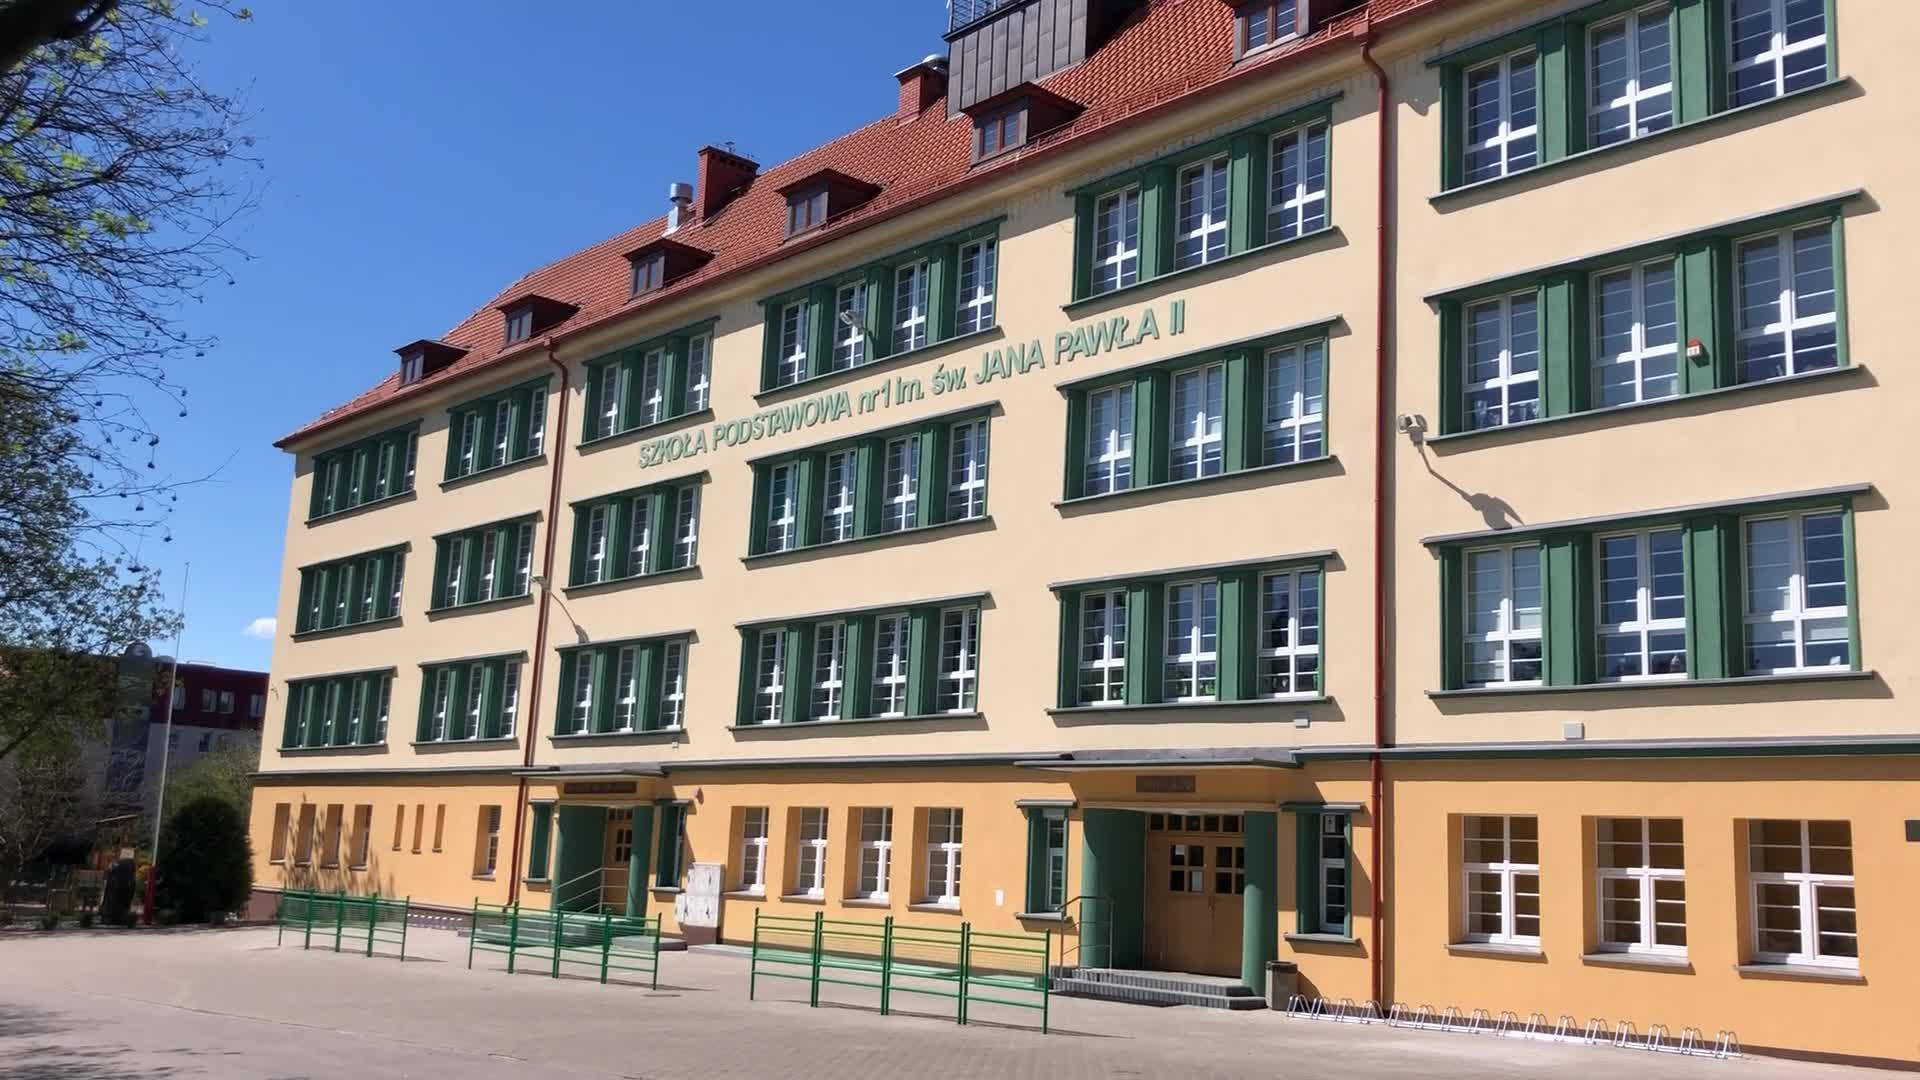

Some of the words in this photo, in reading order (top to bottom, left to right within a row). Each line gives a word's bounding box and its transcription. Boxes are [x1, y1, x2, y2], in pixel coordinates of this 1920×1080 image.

[640, 429, 707, 468] SZKOŁA
[712, 391, 852, 450] PODSTAWOWA
[932, 363, 966, 395] św.
[974, 340, 1045, 384] JANA
[1055, 308, 1160, 365] PAWŁA
[1170, 299, 1186, 336] II
